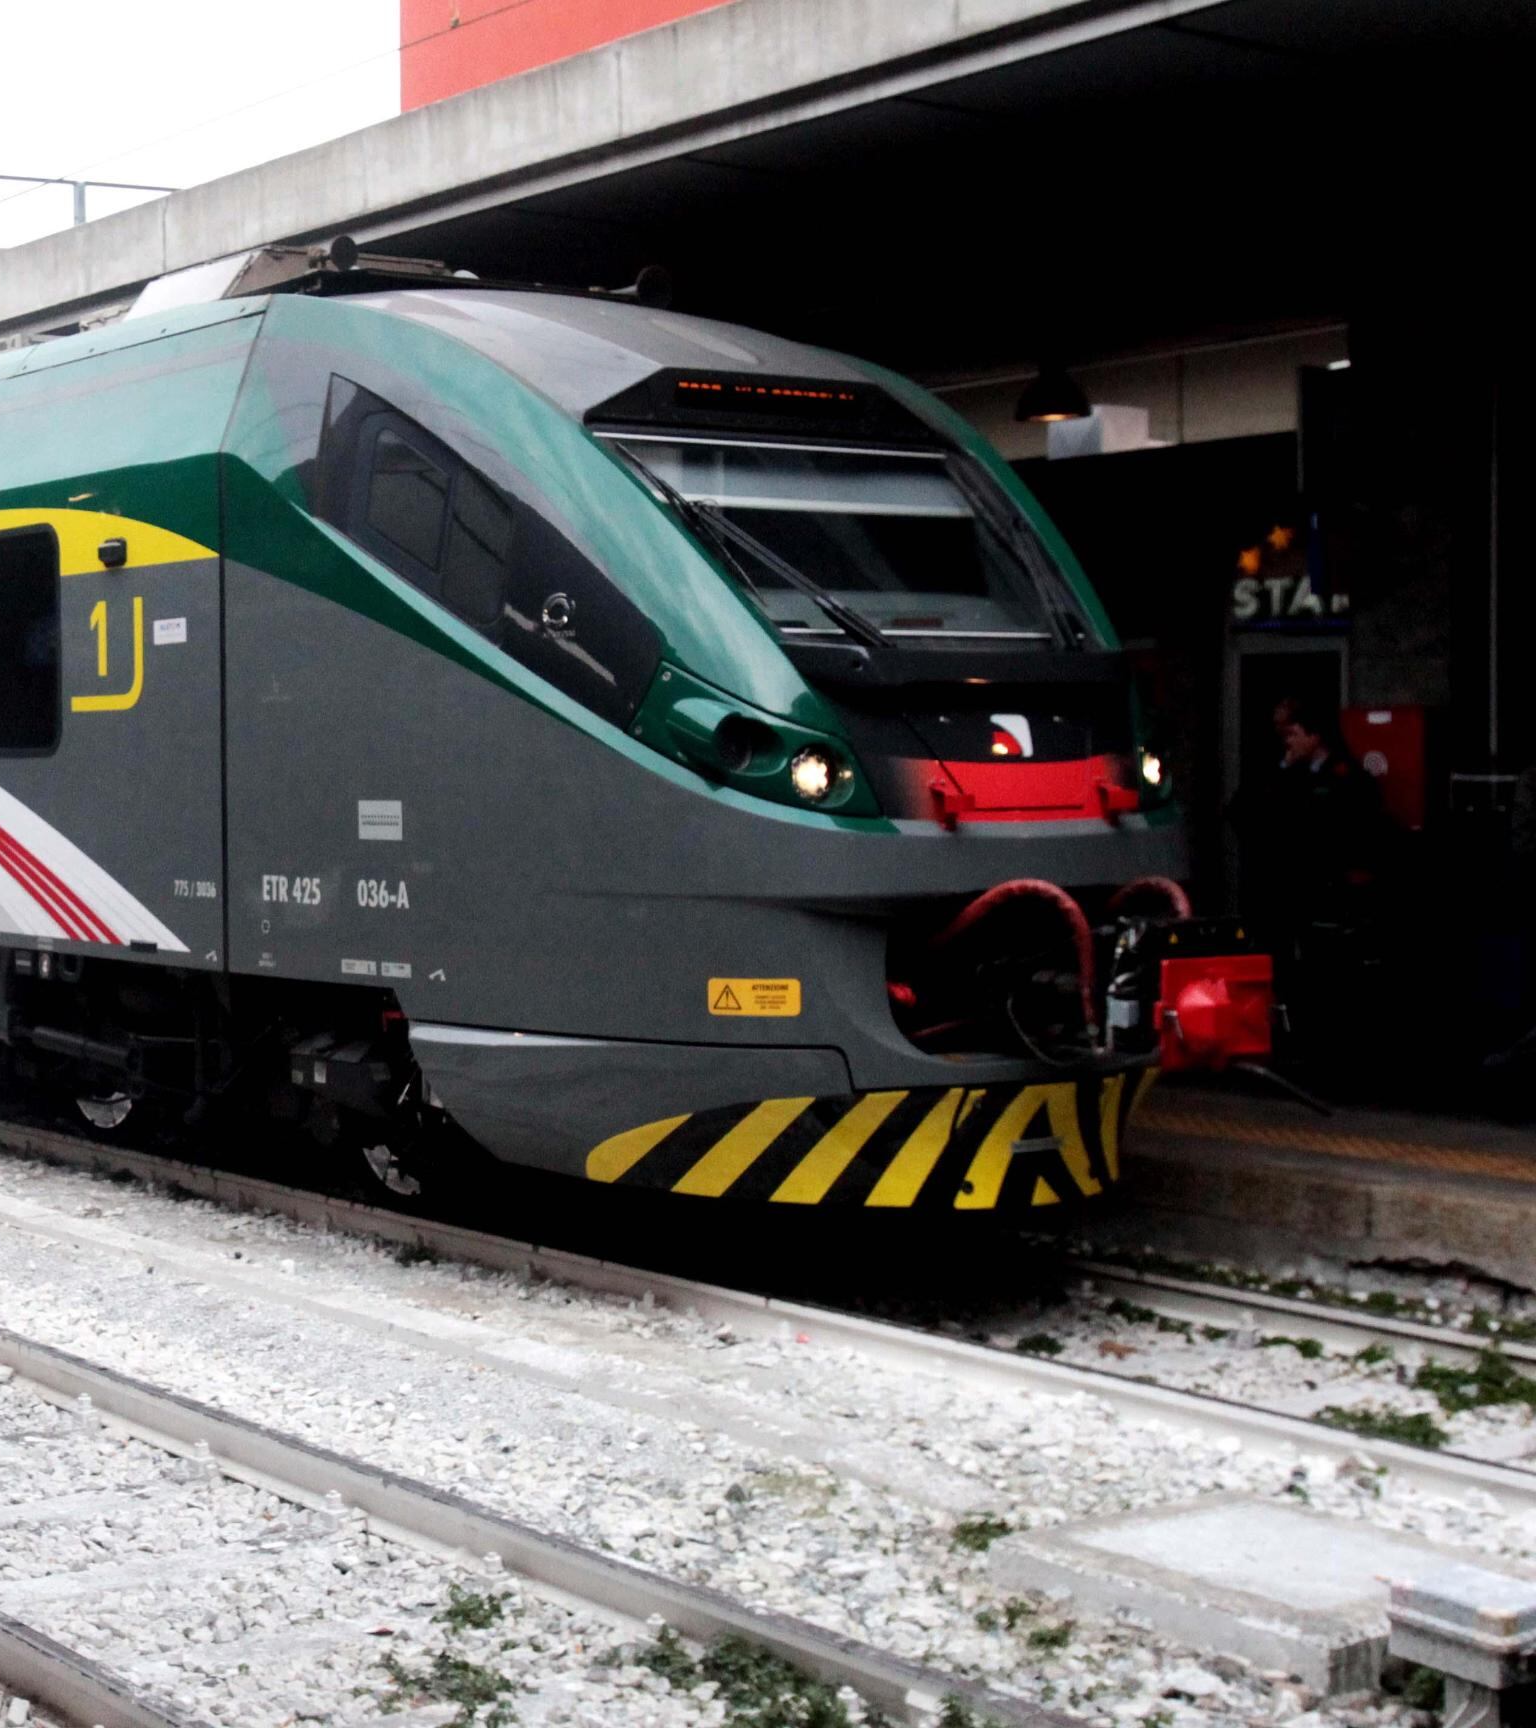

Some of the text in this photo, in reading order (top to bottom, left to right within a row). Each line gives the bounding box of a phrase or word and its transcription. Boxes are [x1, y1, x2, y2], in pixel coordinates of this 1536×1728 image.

[90, 600, 108, 677] 1
[174, 880, 189, 897] 775
[262, 874, 321, 905] ETR 425
[357, 879, 410, 909] 036-A
